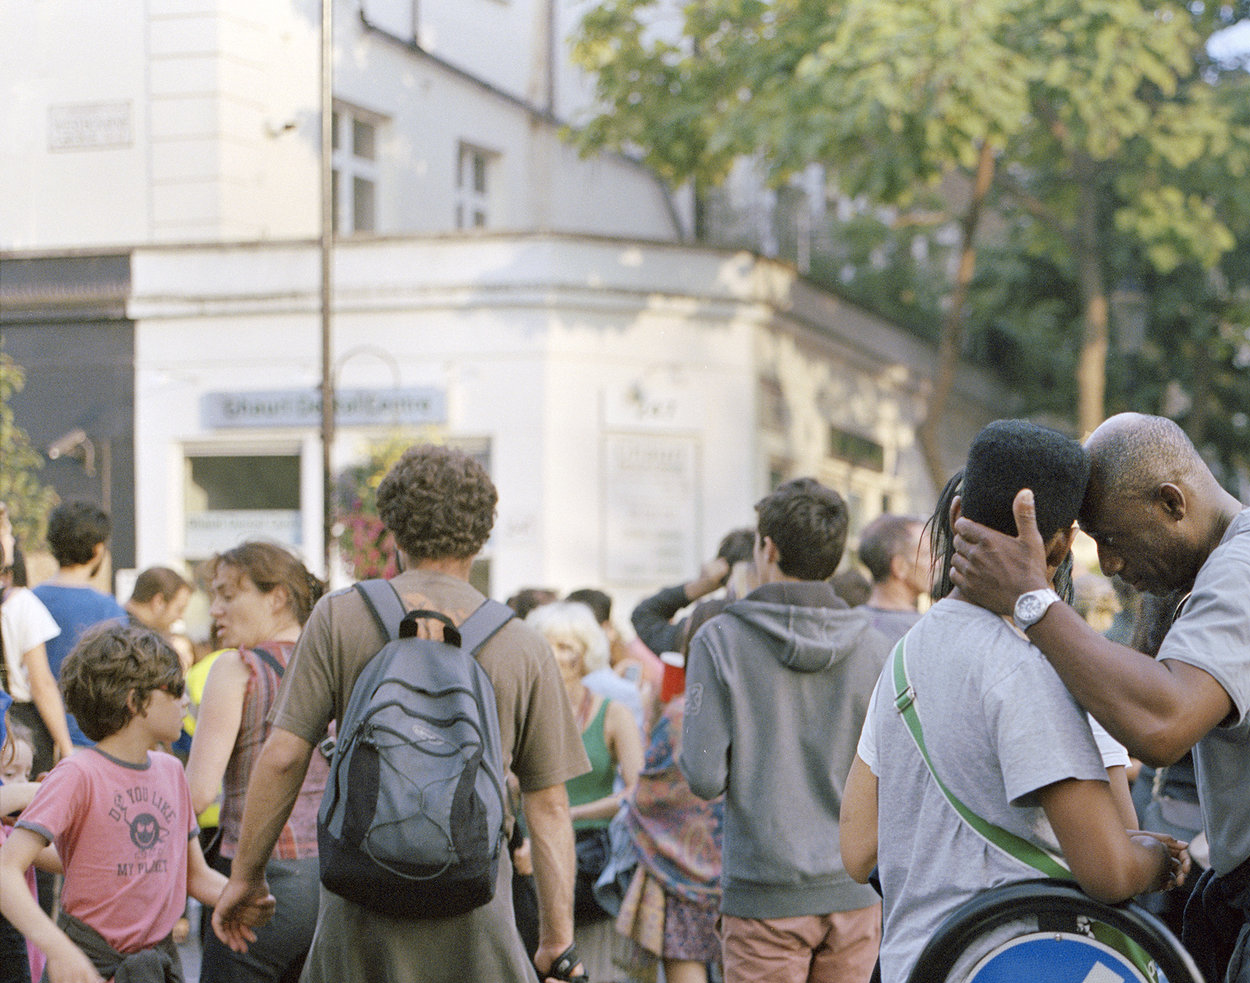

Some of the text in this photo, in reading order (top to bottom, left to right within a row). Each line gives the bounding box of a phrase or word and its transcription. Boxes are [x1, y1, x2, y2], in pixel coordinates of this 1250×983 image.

[126, 785, 148, 804] YOU
[152, 791, 176, 823] LIKE
[117, 863, 134, 876] MY
